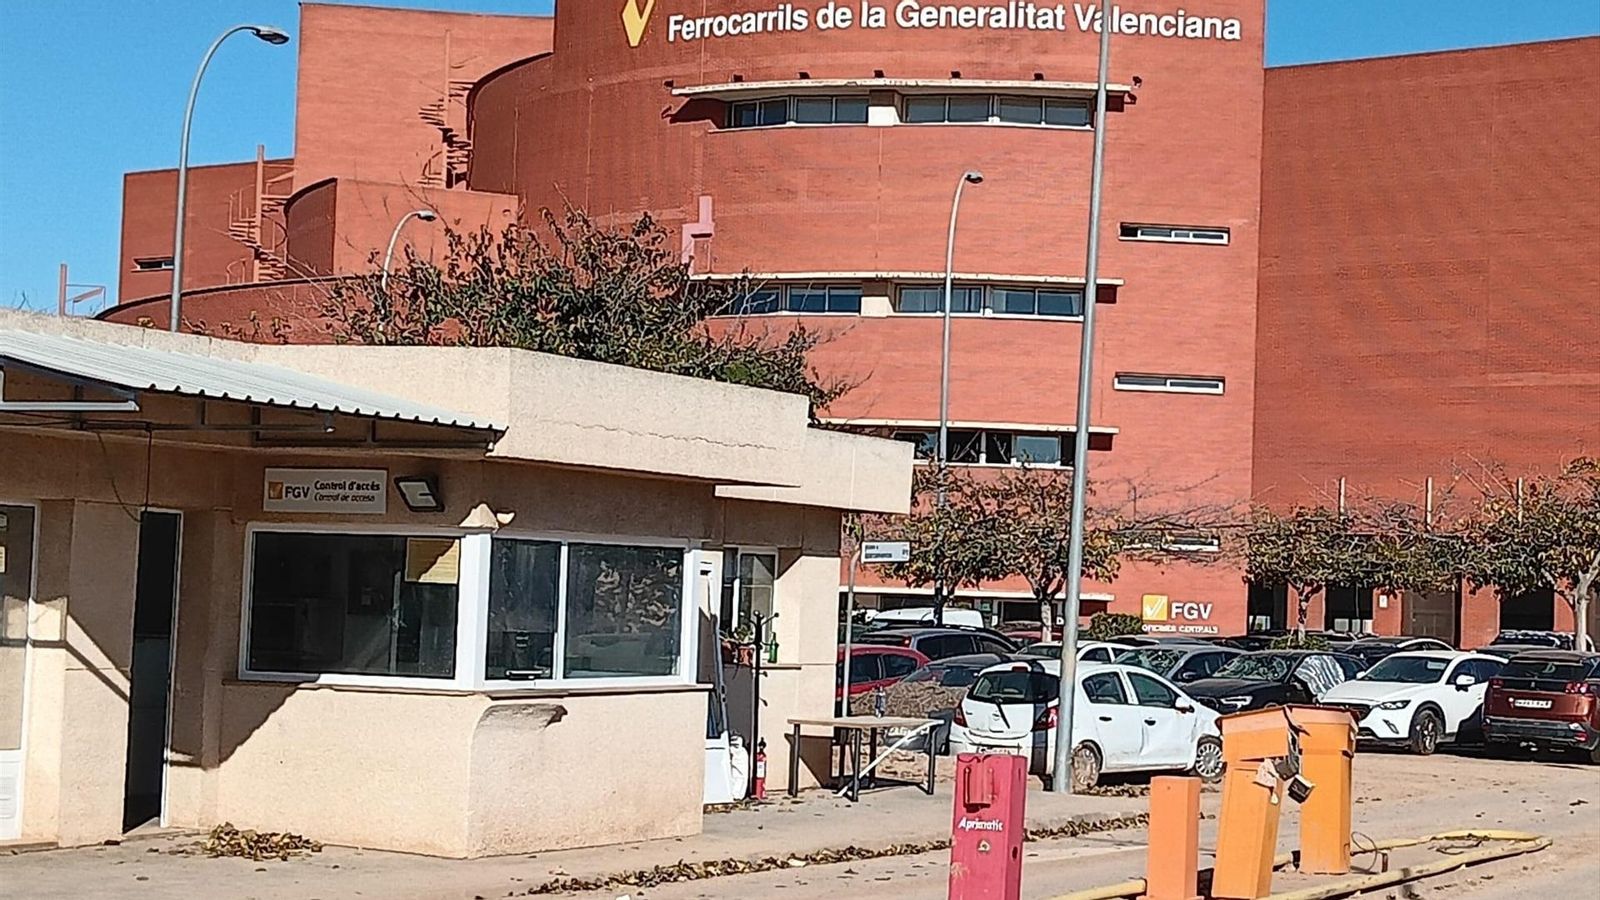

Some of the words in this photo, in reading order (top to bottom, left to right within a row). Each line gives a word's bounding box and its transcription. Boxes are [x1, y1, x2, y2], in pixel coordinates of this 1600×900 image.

[668, 3, 809, 42] Ferrocarrils
[816, 1, 853, 30] de
[860, 0, 886, 28] la
[895, 0, 1066, 31] Generalitat
[1073, 3, 1241, 41] Valenciana
[285, 486, 310, 499] FGV
[314, 480, 346, 491] Control
[1171, 602, 1212, 619] FGV
